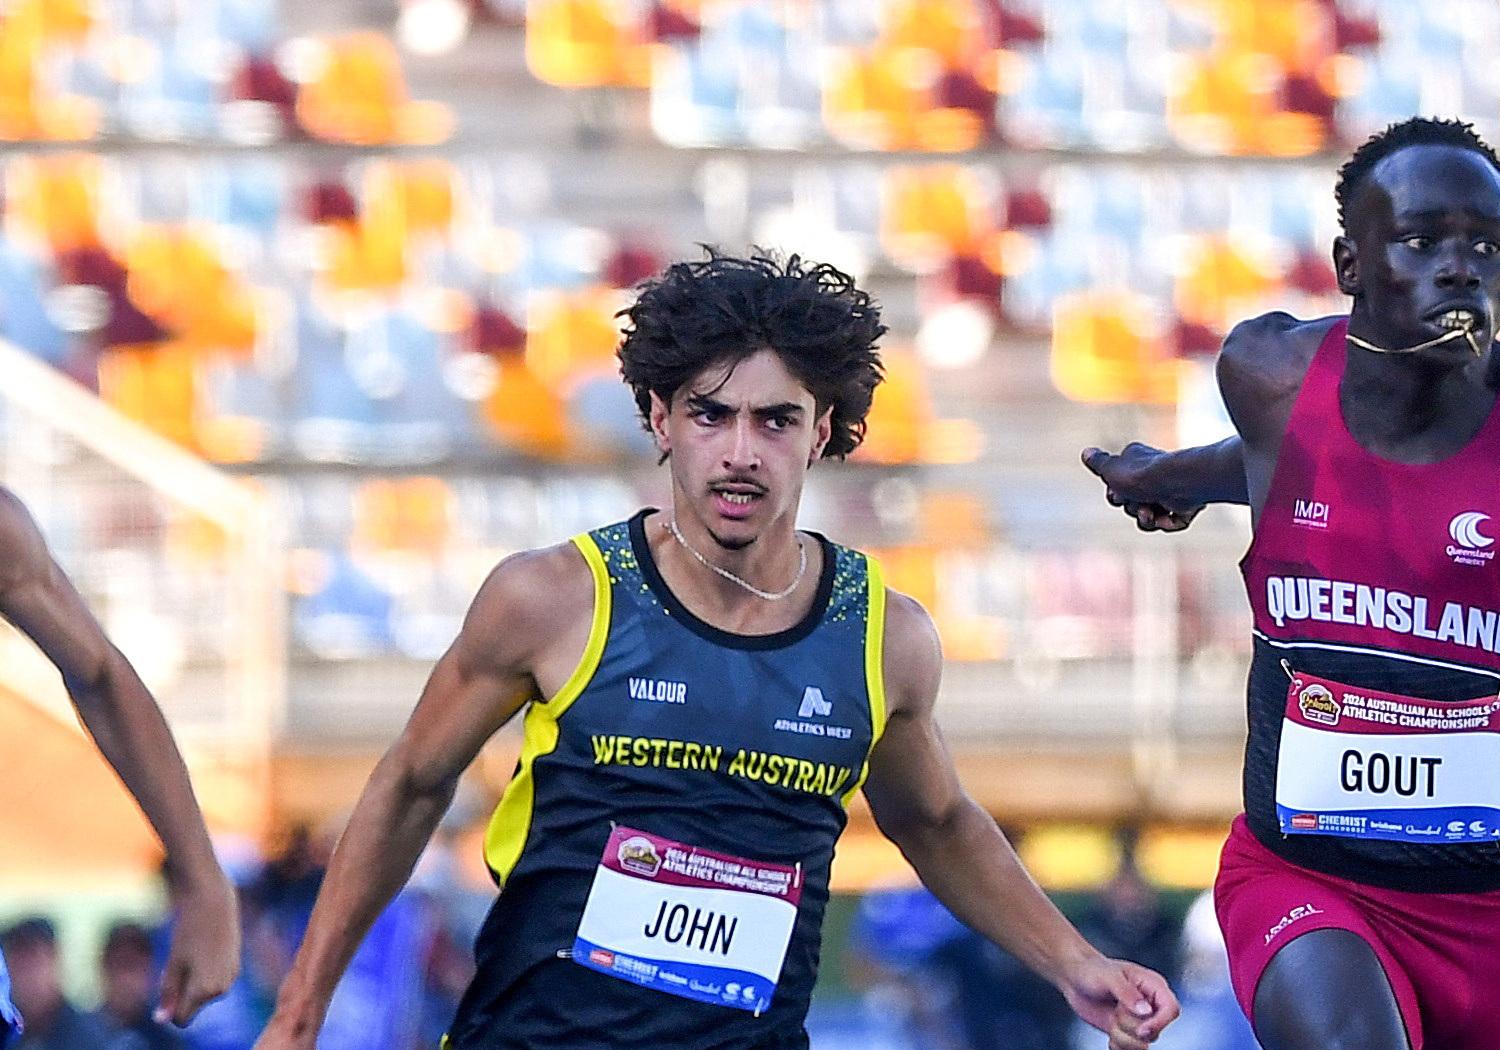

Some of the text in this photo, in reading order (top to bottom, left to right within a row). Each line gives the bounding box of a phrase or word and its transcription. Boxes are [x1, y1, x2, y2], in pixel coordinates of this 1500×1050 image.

[1294, 499, 1329, 521] IMPI
[1446, 545, 1495, 564] Queensland
[628, 677, 687, 704] VALOUR
[1342, 693, 1491, 719] 2024 AUSTRALIAN ALL SCHOOLS
[1342, 705, 1489, 730] ATHLETICS CHAMPIONSHIPS
[774, 719, 852, 739] ATHLETICS WEST
[591, 735, 722, 772] WESTERN
[1340, 749, 1442, 798] GOUT
[1318, 815, 1367, 827] CHEMIST
[662, 860, 713, 881] ATHLETICS
[644, 900, 739, 955] JOHN
